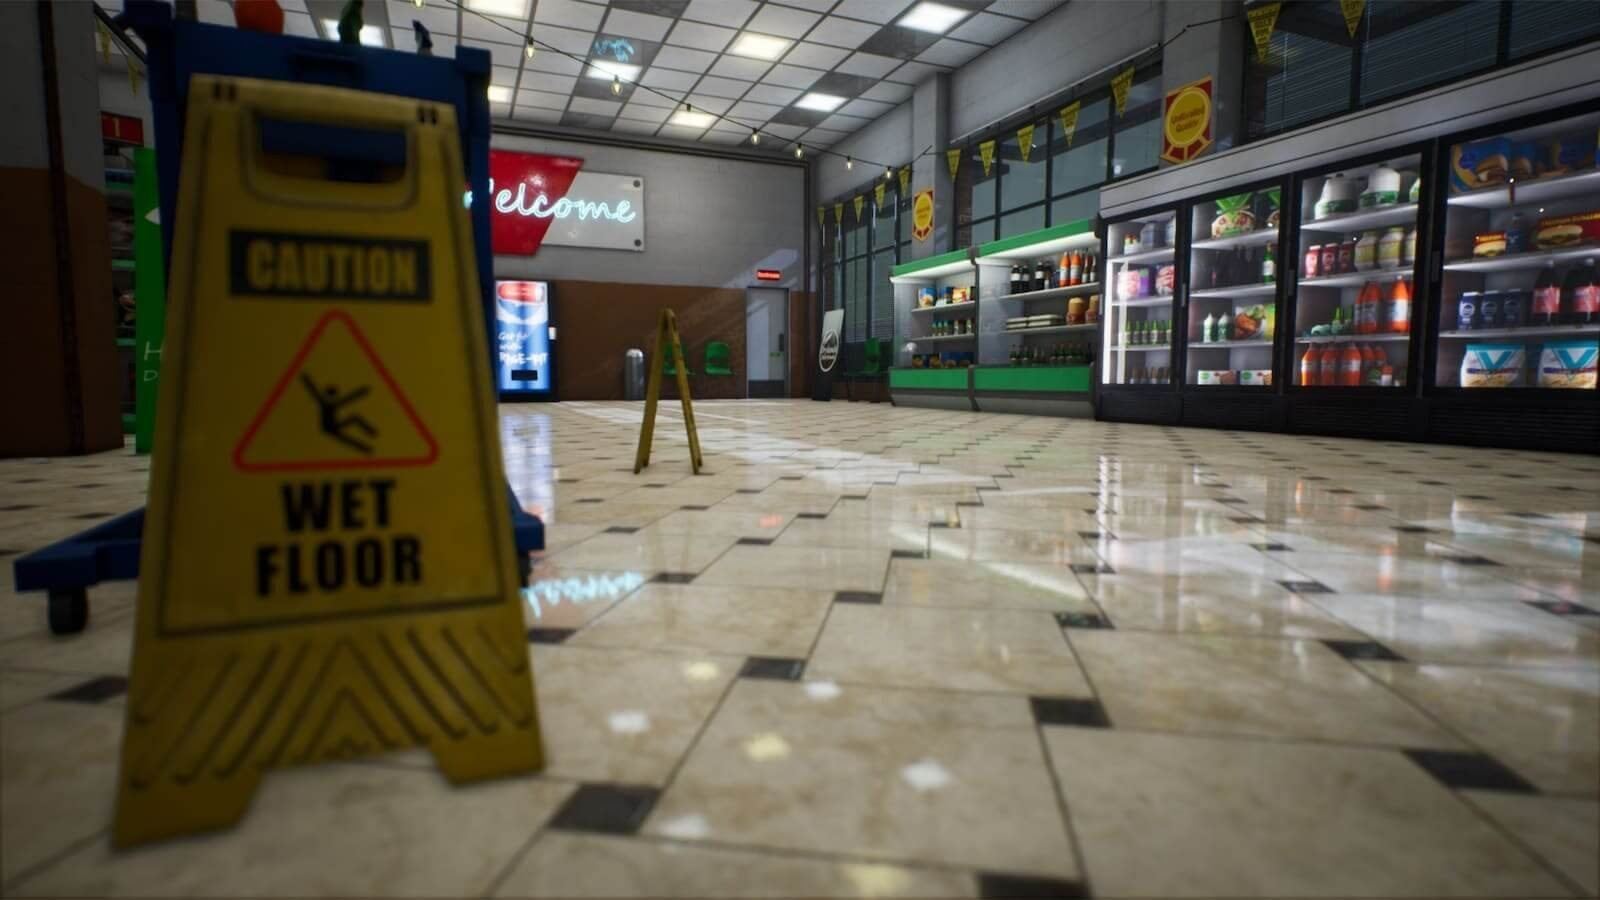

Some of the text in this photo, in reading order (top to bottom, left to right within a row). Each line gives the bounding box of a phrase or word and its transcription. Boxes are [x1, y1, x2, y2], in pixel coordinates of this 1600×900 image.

[247, 239, 418, 295] CAUTION
[281, 480, 396, 532] WET
[256, 534, 423, 597] FLOOR
